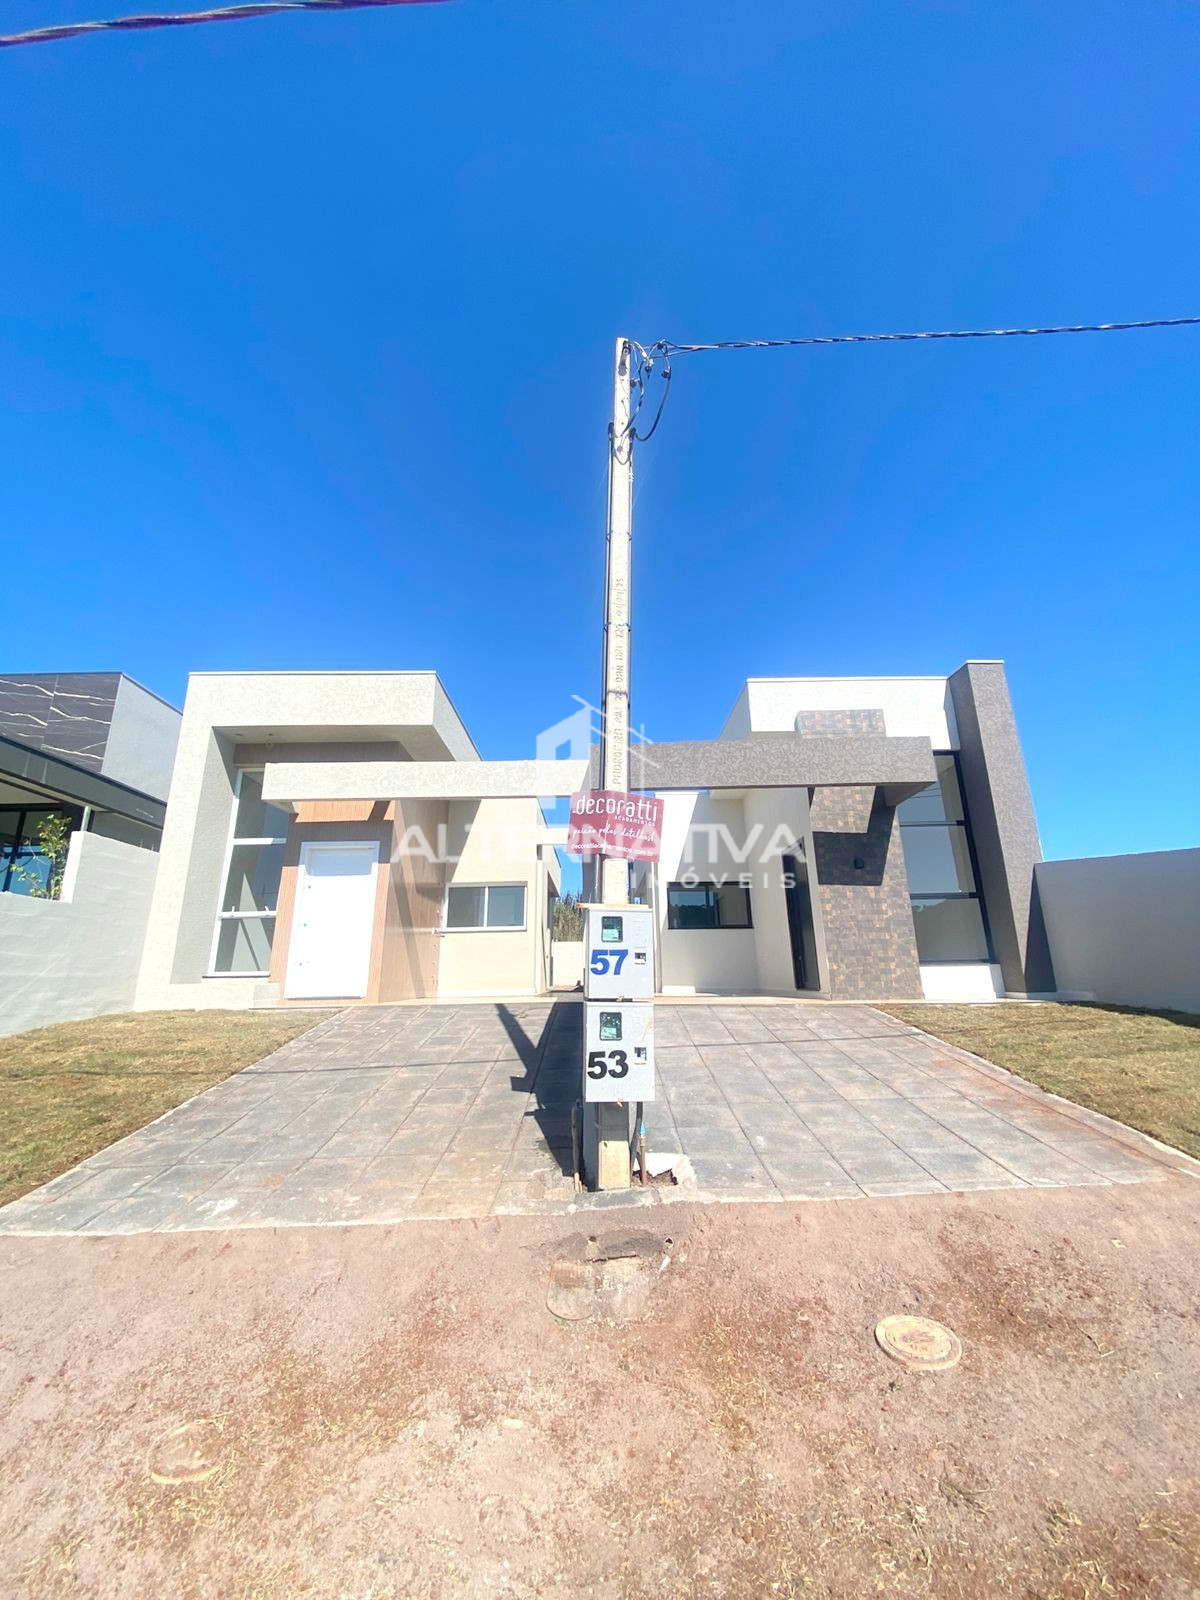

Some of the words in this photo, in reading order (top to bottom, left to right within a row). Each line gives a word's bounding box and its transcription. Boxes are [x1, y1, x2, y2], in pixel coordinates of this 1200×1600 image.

[576, 795, 658, 822] decoratti
[590, 949, 629, 976] 57
[587, 1050, 630, 1080] 53
